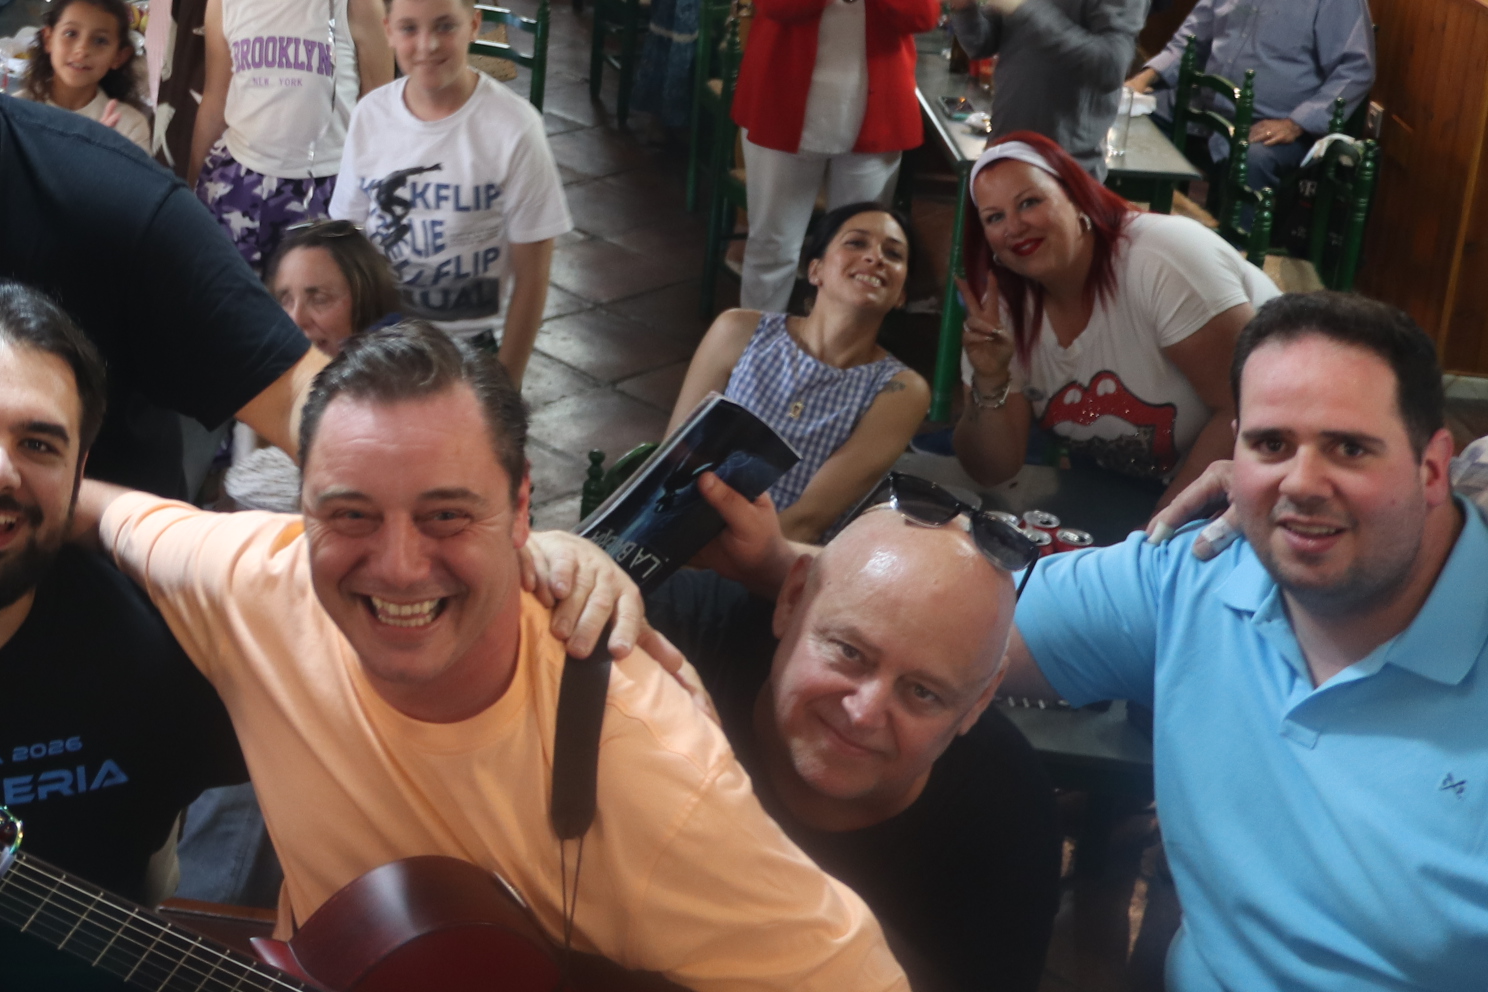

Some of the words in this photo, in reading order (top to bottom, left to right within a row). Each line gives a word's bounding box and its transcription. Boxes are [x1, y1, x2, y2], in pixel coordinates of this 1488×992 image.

[232, 36, 334, 77] BROOKLYN
[253, 77, 270, 87] NEW
[278, 77, 303, 87] YORK
[628, 547, 662, 580] LA
[12, 735, 83, 762] 2026
